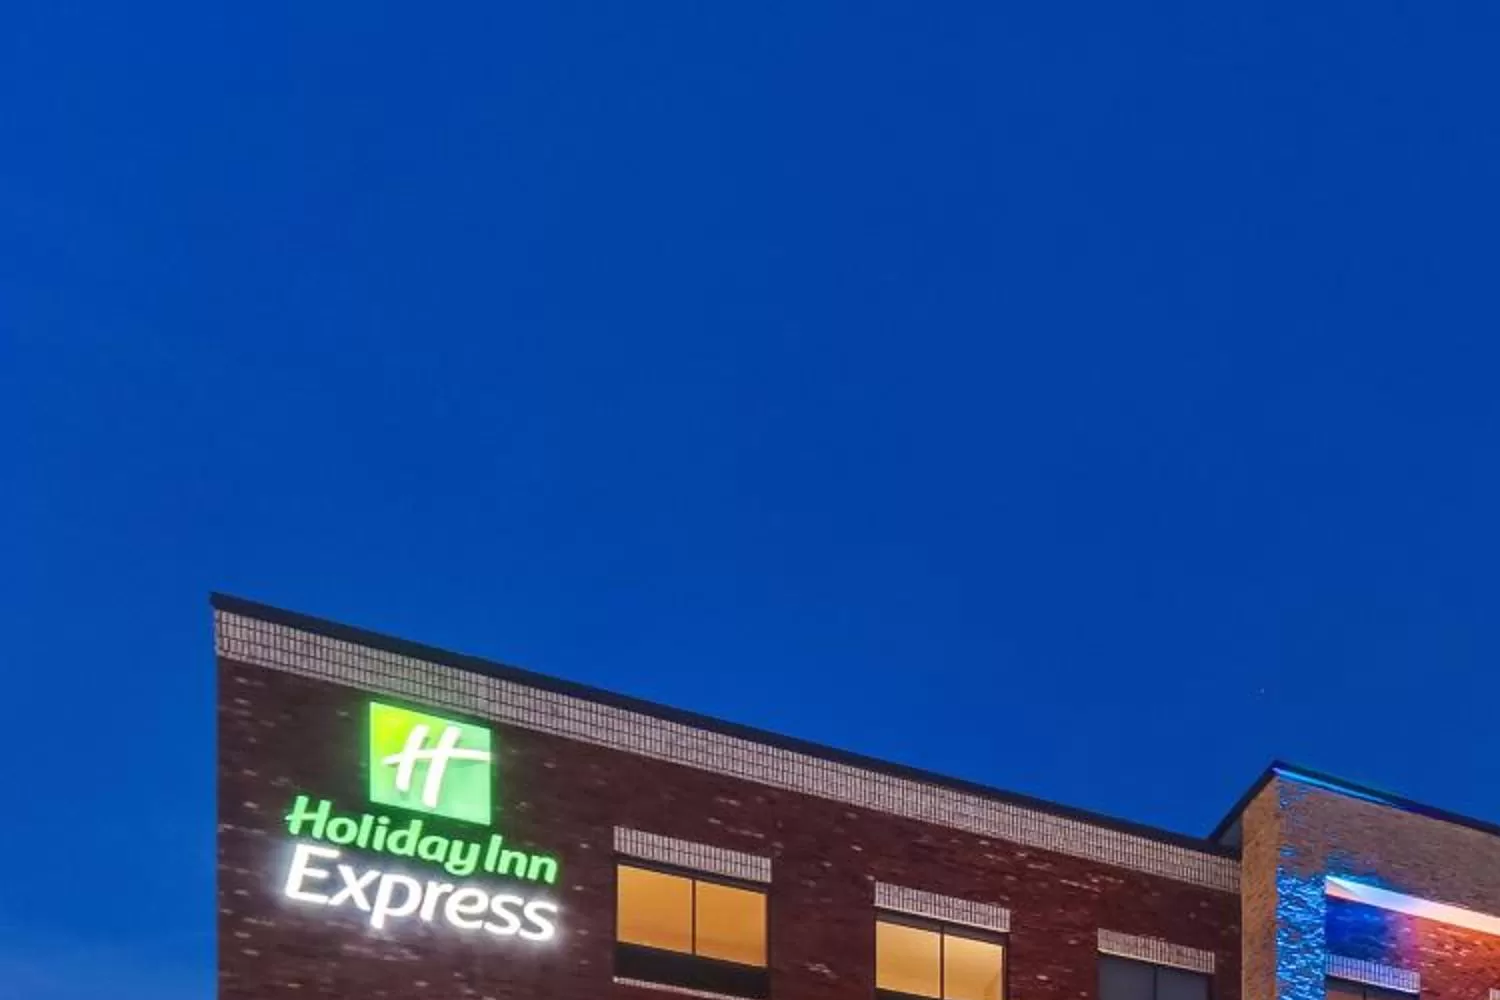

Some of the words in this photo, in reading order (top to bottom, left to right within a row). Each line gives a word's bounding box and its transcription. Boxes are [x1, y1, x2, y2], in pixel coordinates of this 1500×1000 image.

[285, 795, 481, 876] Holiday
[484, 834, 558, 884] Inn
[284, 843, 559, 941] Express
